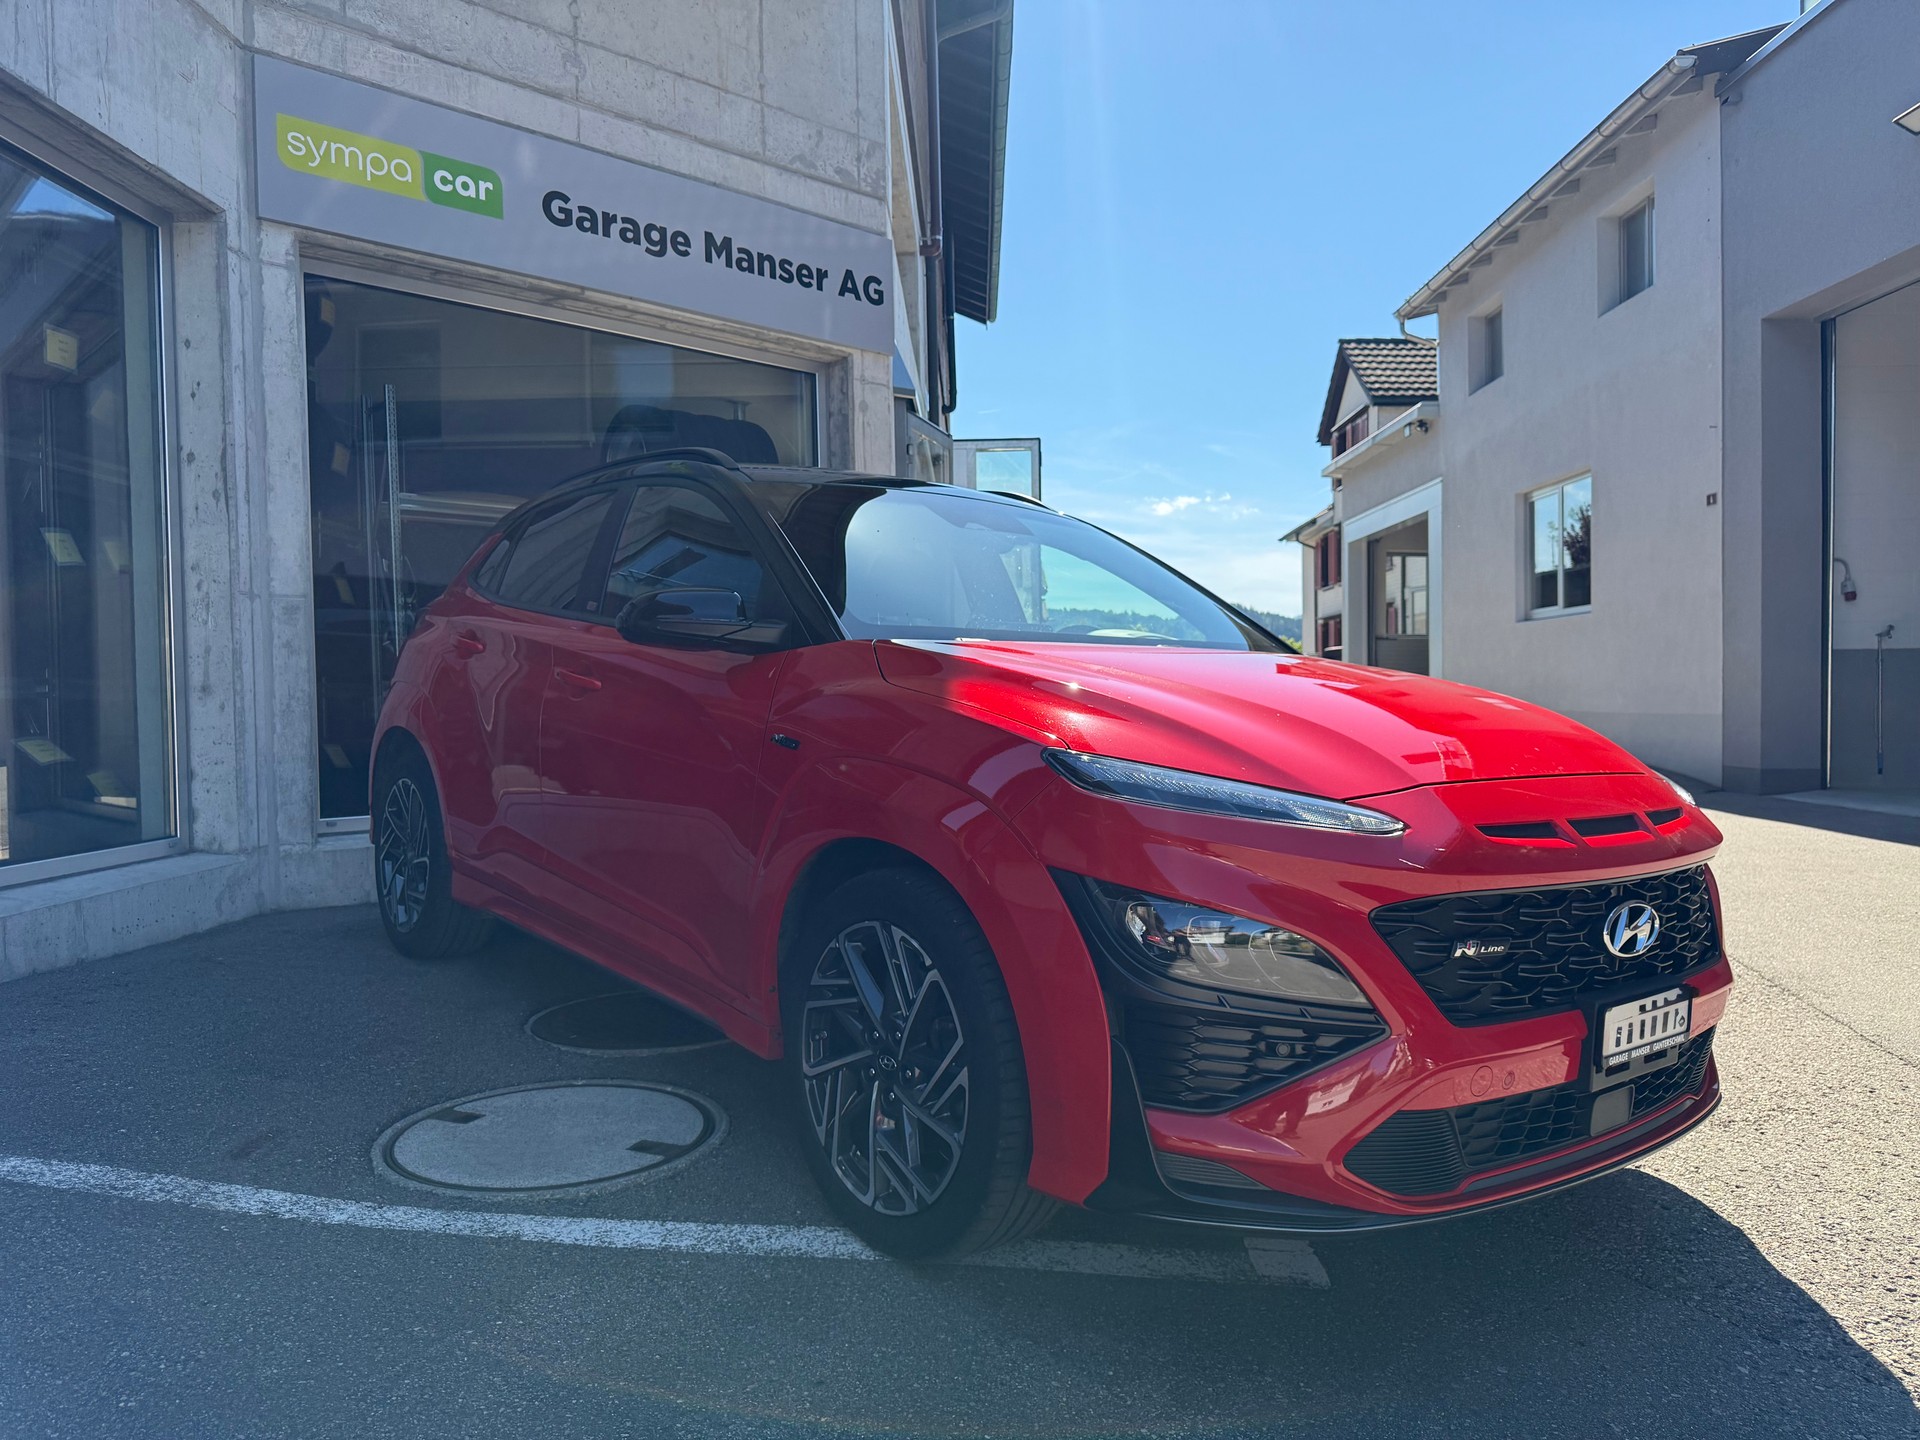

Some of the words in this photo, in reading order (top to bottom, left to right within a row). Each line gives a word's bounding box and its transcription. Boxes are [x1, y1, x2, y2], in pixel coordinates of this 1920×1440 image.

[286, 131, 413, 182] sympa
[433, 169, 494, 201] car
[541, 190, 692, 258] Garage
[703, 230, 828, 292] Manser
[837, 268, 885, 307] AG
[1480, 945, 1505, 953] Line
[1608, 1052, 1629, 1066] GARAGE
[1631, 1045, 1650, 1059] MANSER
